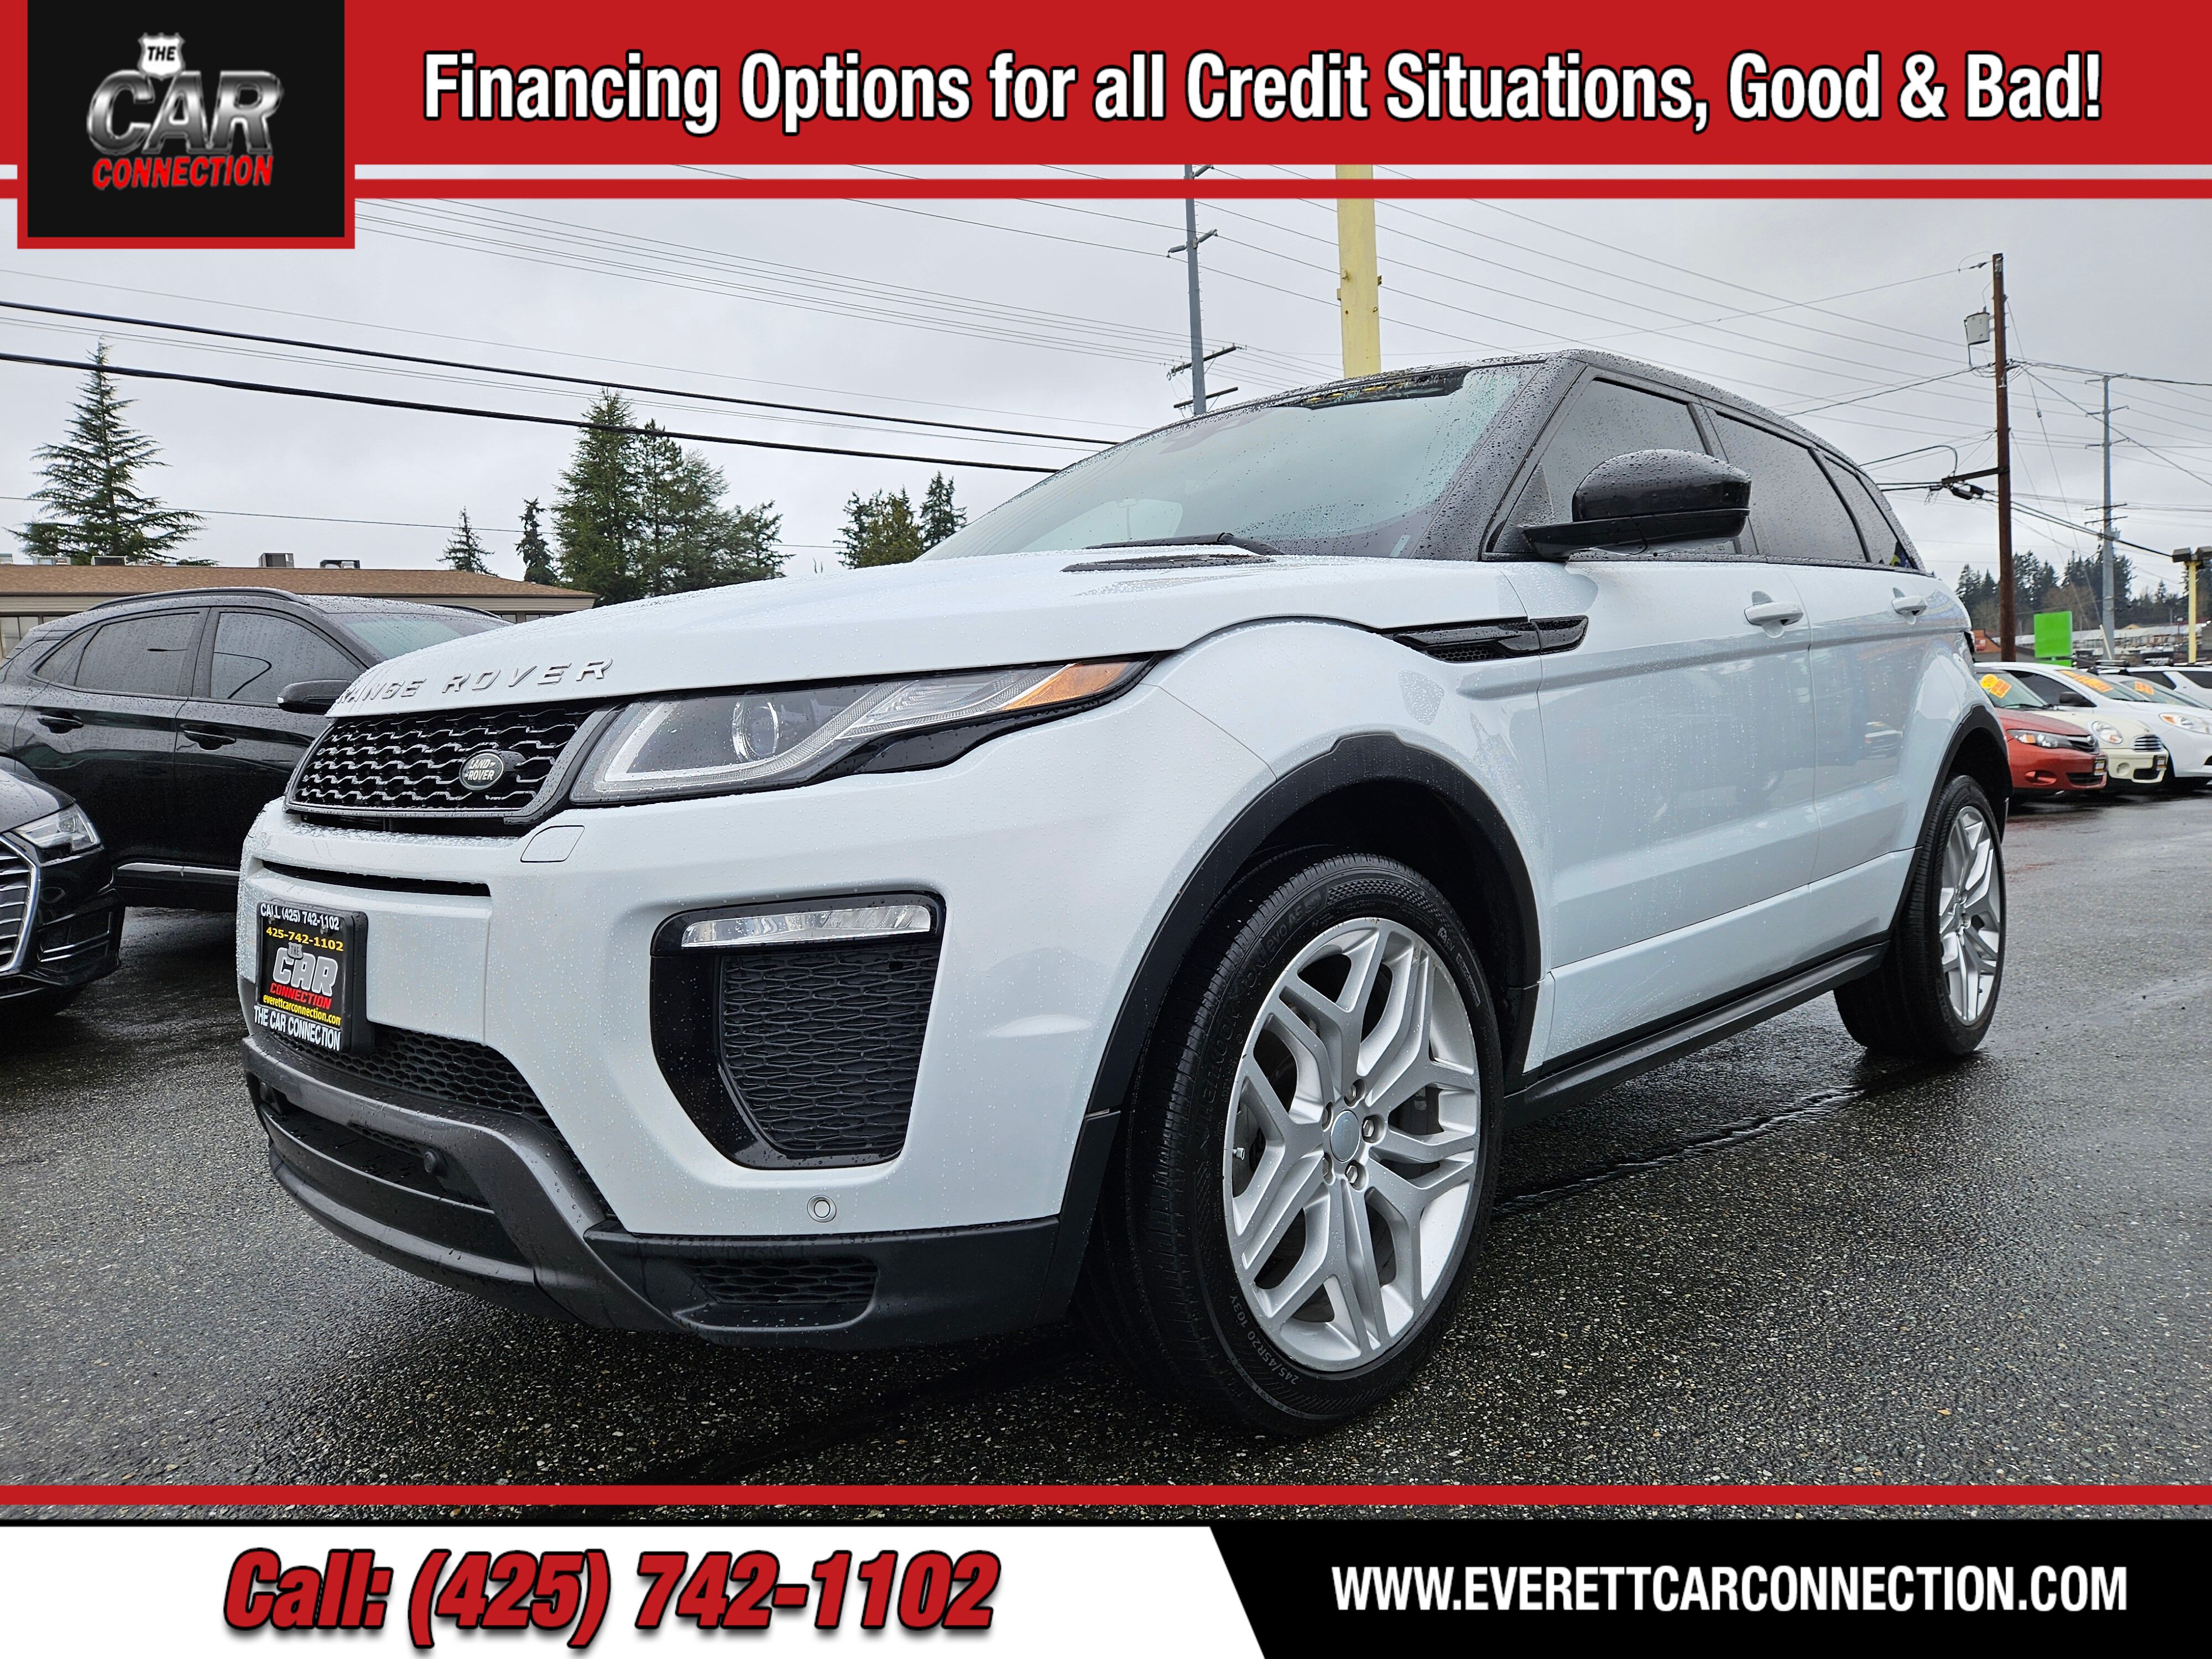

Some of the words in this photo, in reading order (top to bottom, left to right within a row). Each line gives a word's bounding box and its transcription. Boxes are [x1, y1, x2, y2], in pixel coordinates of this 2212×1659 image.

[337, 678, 427, 703] RANGE
[441, 658, 613, 693] ROVER
[467, 769, 495, 781] ROVER
[468, 758, 492, 770] LAND
[260, 903, 281, 920] CALL
[281, 906, 301, 924] (425)
[302, 911, 340, 931] 742-1102
[265, 926, 344, 952] 425-742-1102
[290, 945, 300, 957] THE
[273, 947, 338, 997] CAR
[270, 982, 332, 1010] CONNECTION
[254, 1004, 269, 1027] THE
[270, 1009, 286, 1033] CAR
[288, 1017, 341, 1051] CONNECTION
